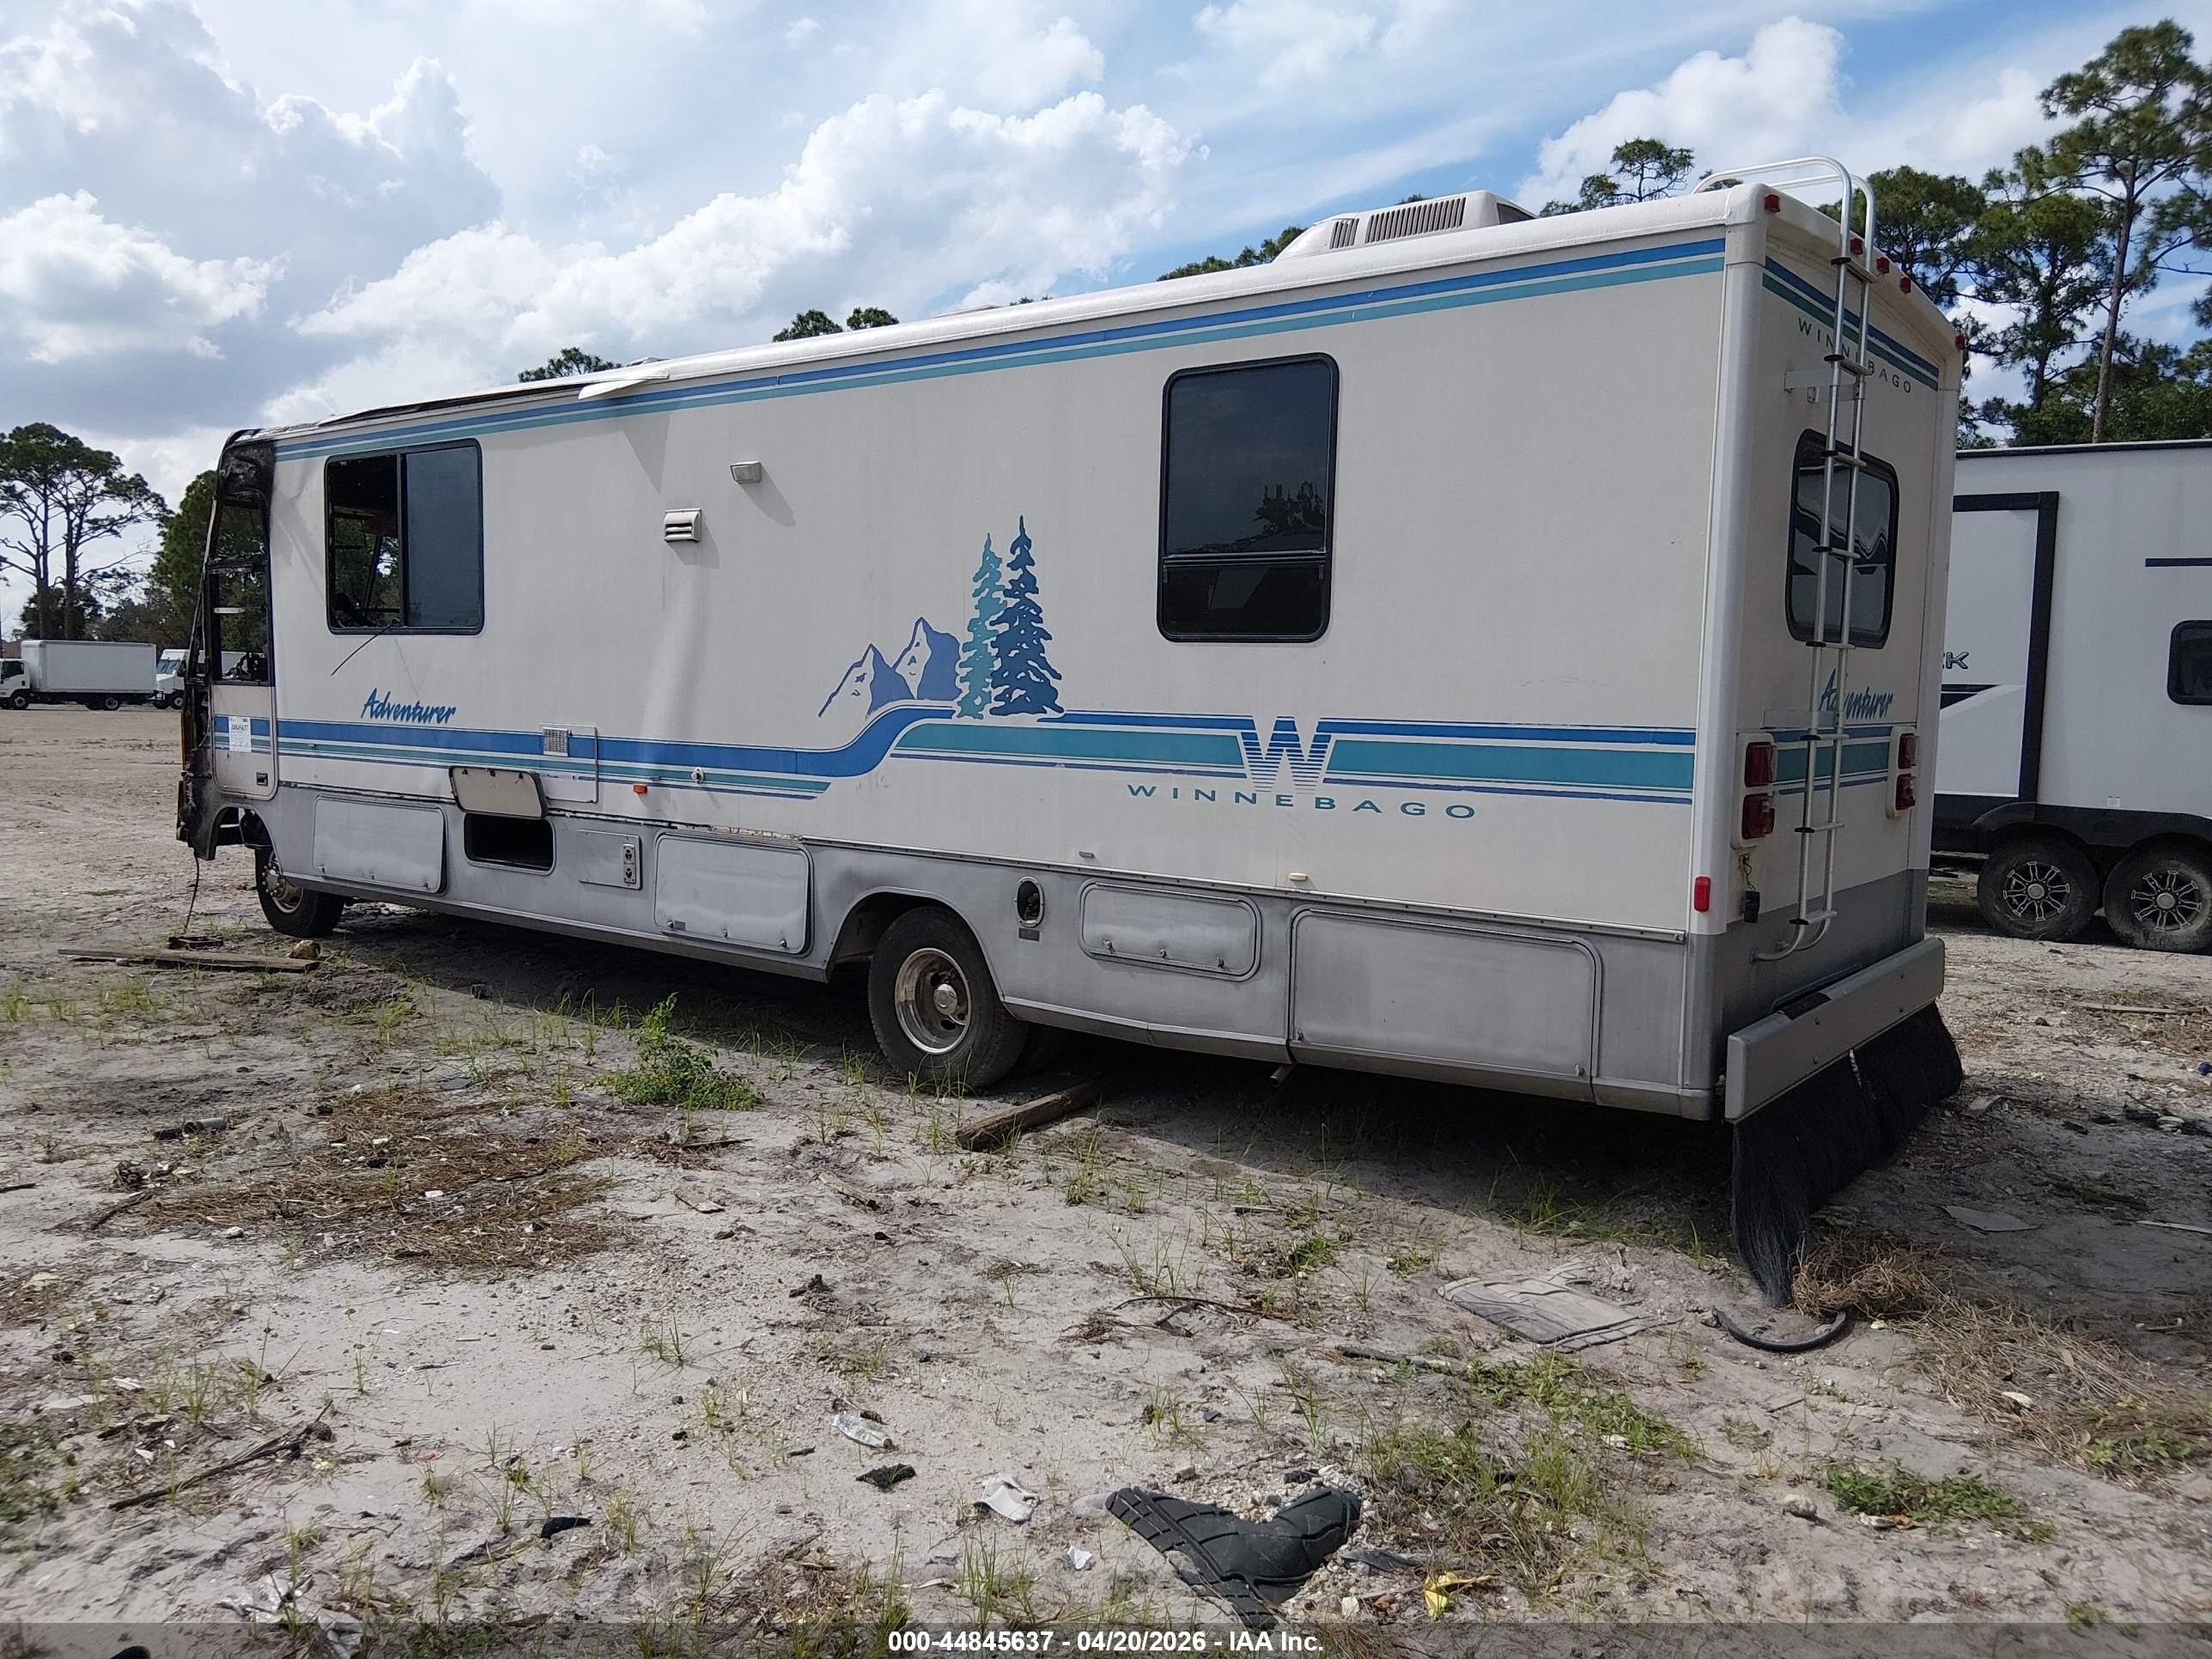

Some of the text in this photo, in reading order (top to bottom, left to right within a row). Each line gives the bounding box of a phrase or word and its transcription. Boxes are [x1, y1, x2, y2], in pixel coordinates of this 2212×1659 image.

[1798, 317, 1911, 393] WINNBAGO
[361, 687, 457, 724] Adventurer
[1127, 784, 1475, 819] WINNEBAGO
